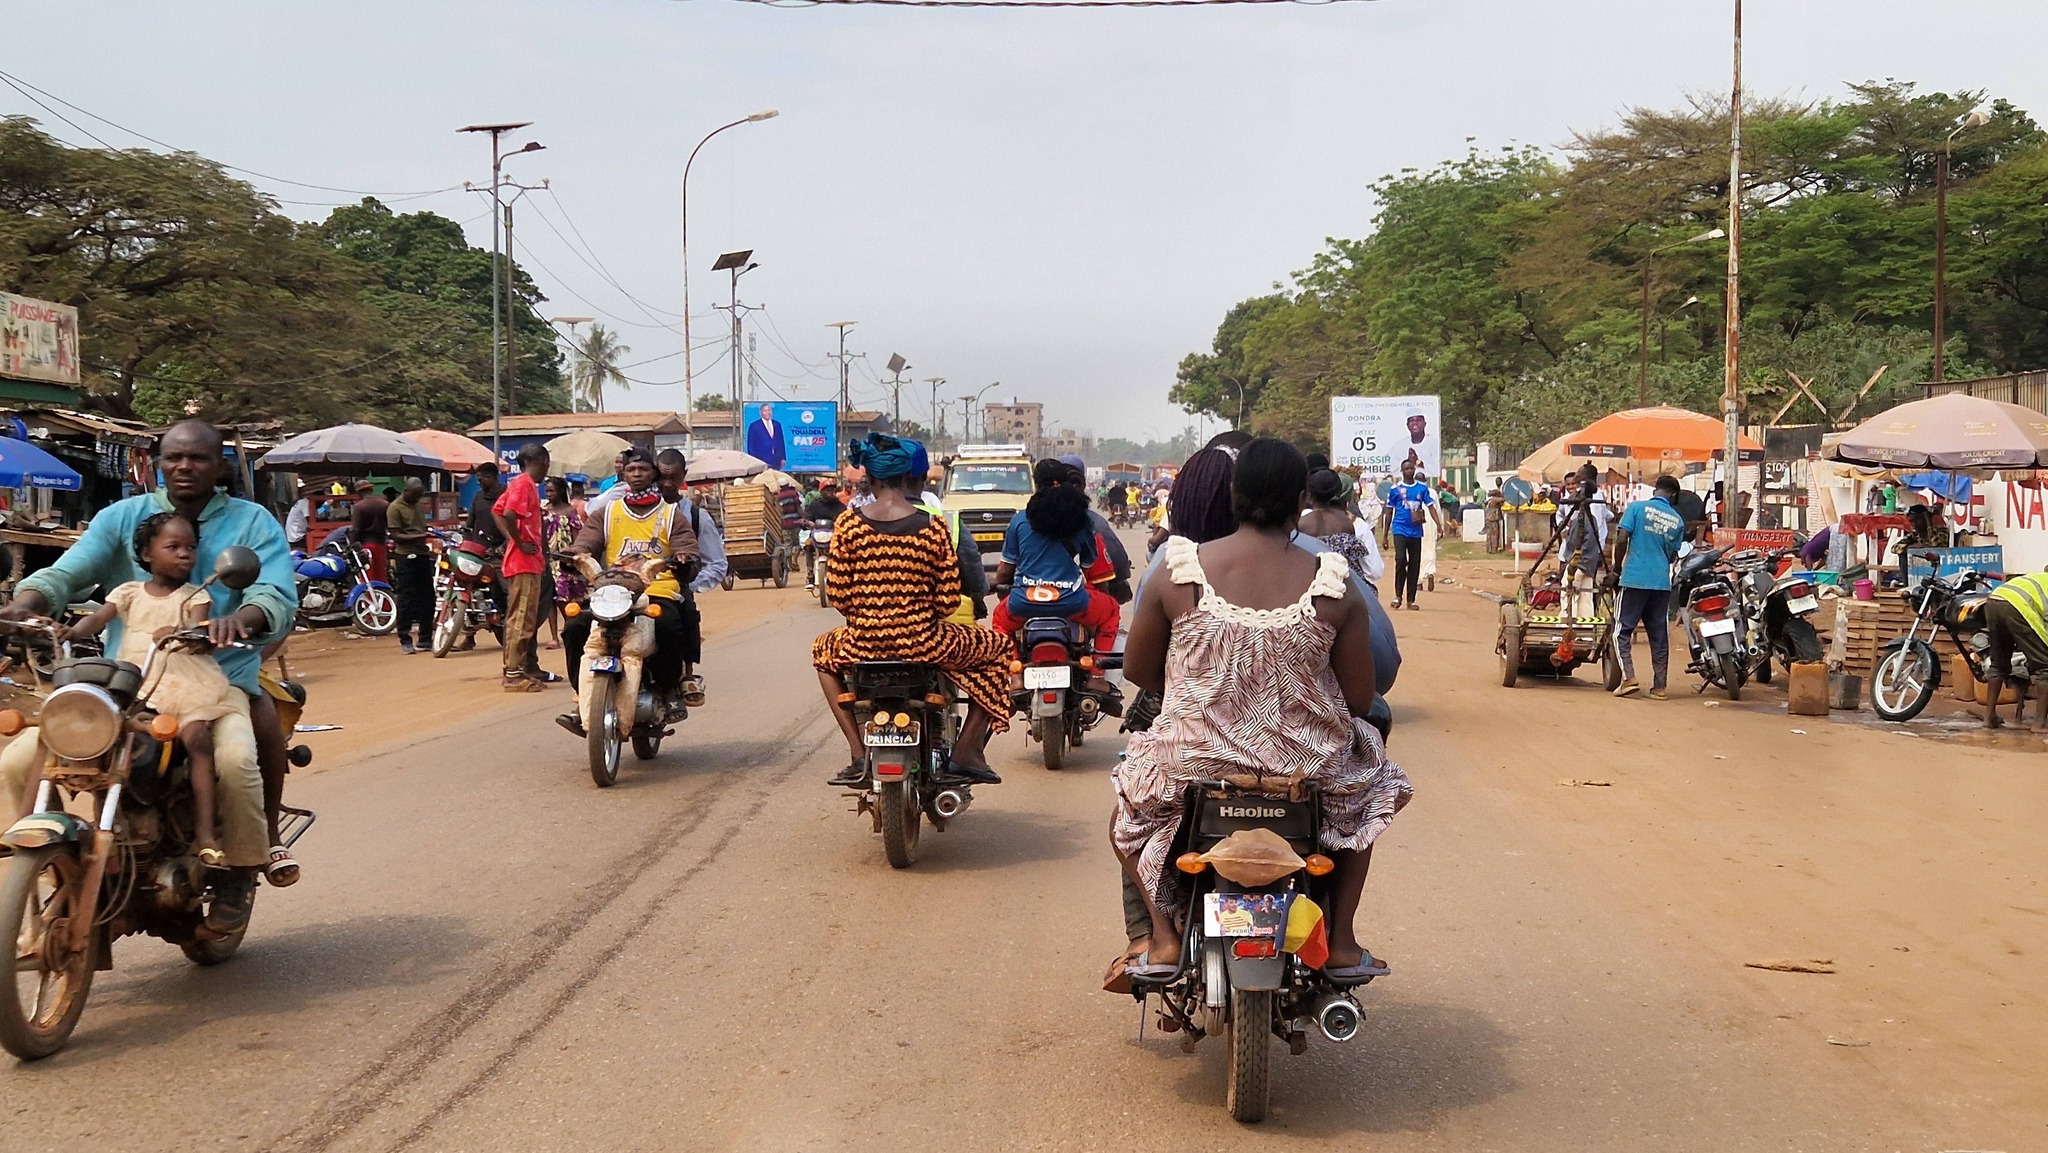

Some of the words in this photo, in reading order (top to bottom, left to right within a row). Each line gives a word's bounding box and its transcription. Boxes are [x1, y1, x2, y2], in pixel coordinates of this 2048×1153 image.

[1352, 436, 1377, 451] 05
[1350, 453, 1391, 464] RÉUSSIR
[1765, 462, 1788, 473] STOP
[1940, 552, 2000, 565] TRANSFERT
[1022, 576, 1074, 589] boulanger
[867, 734, 913, 744] PRINCIA
